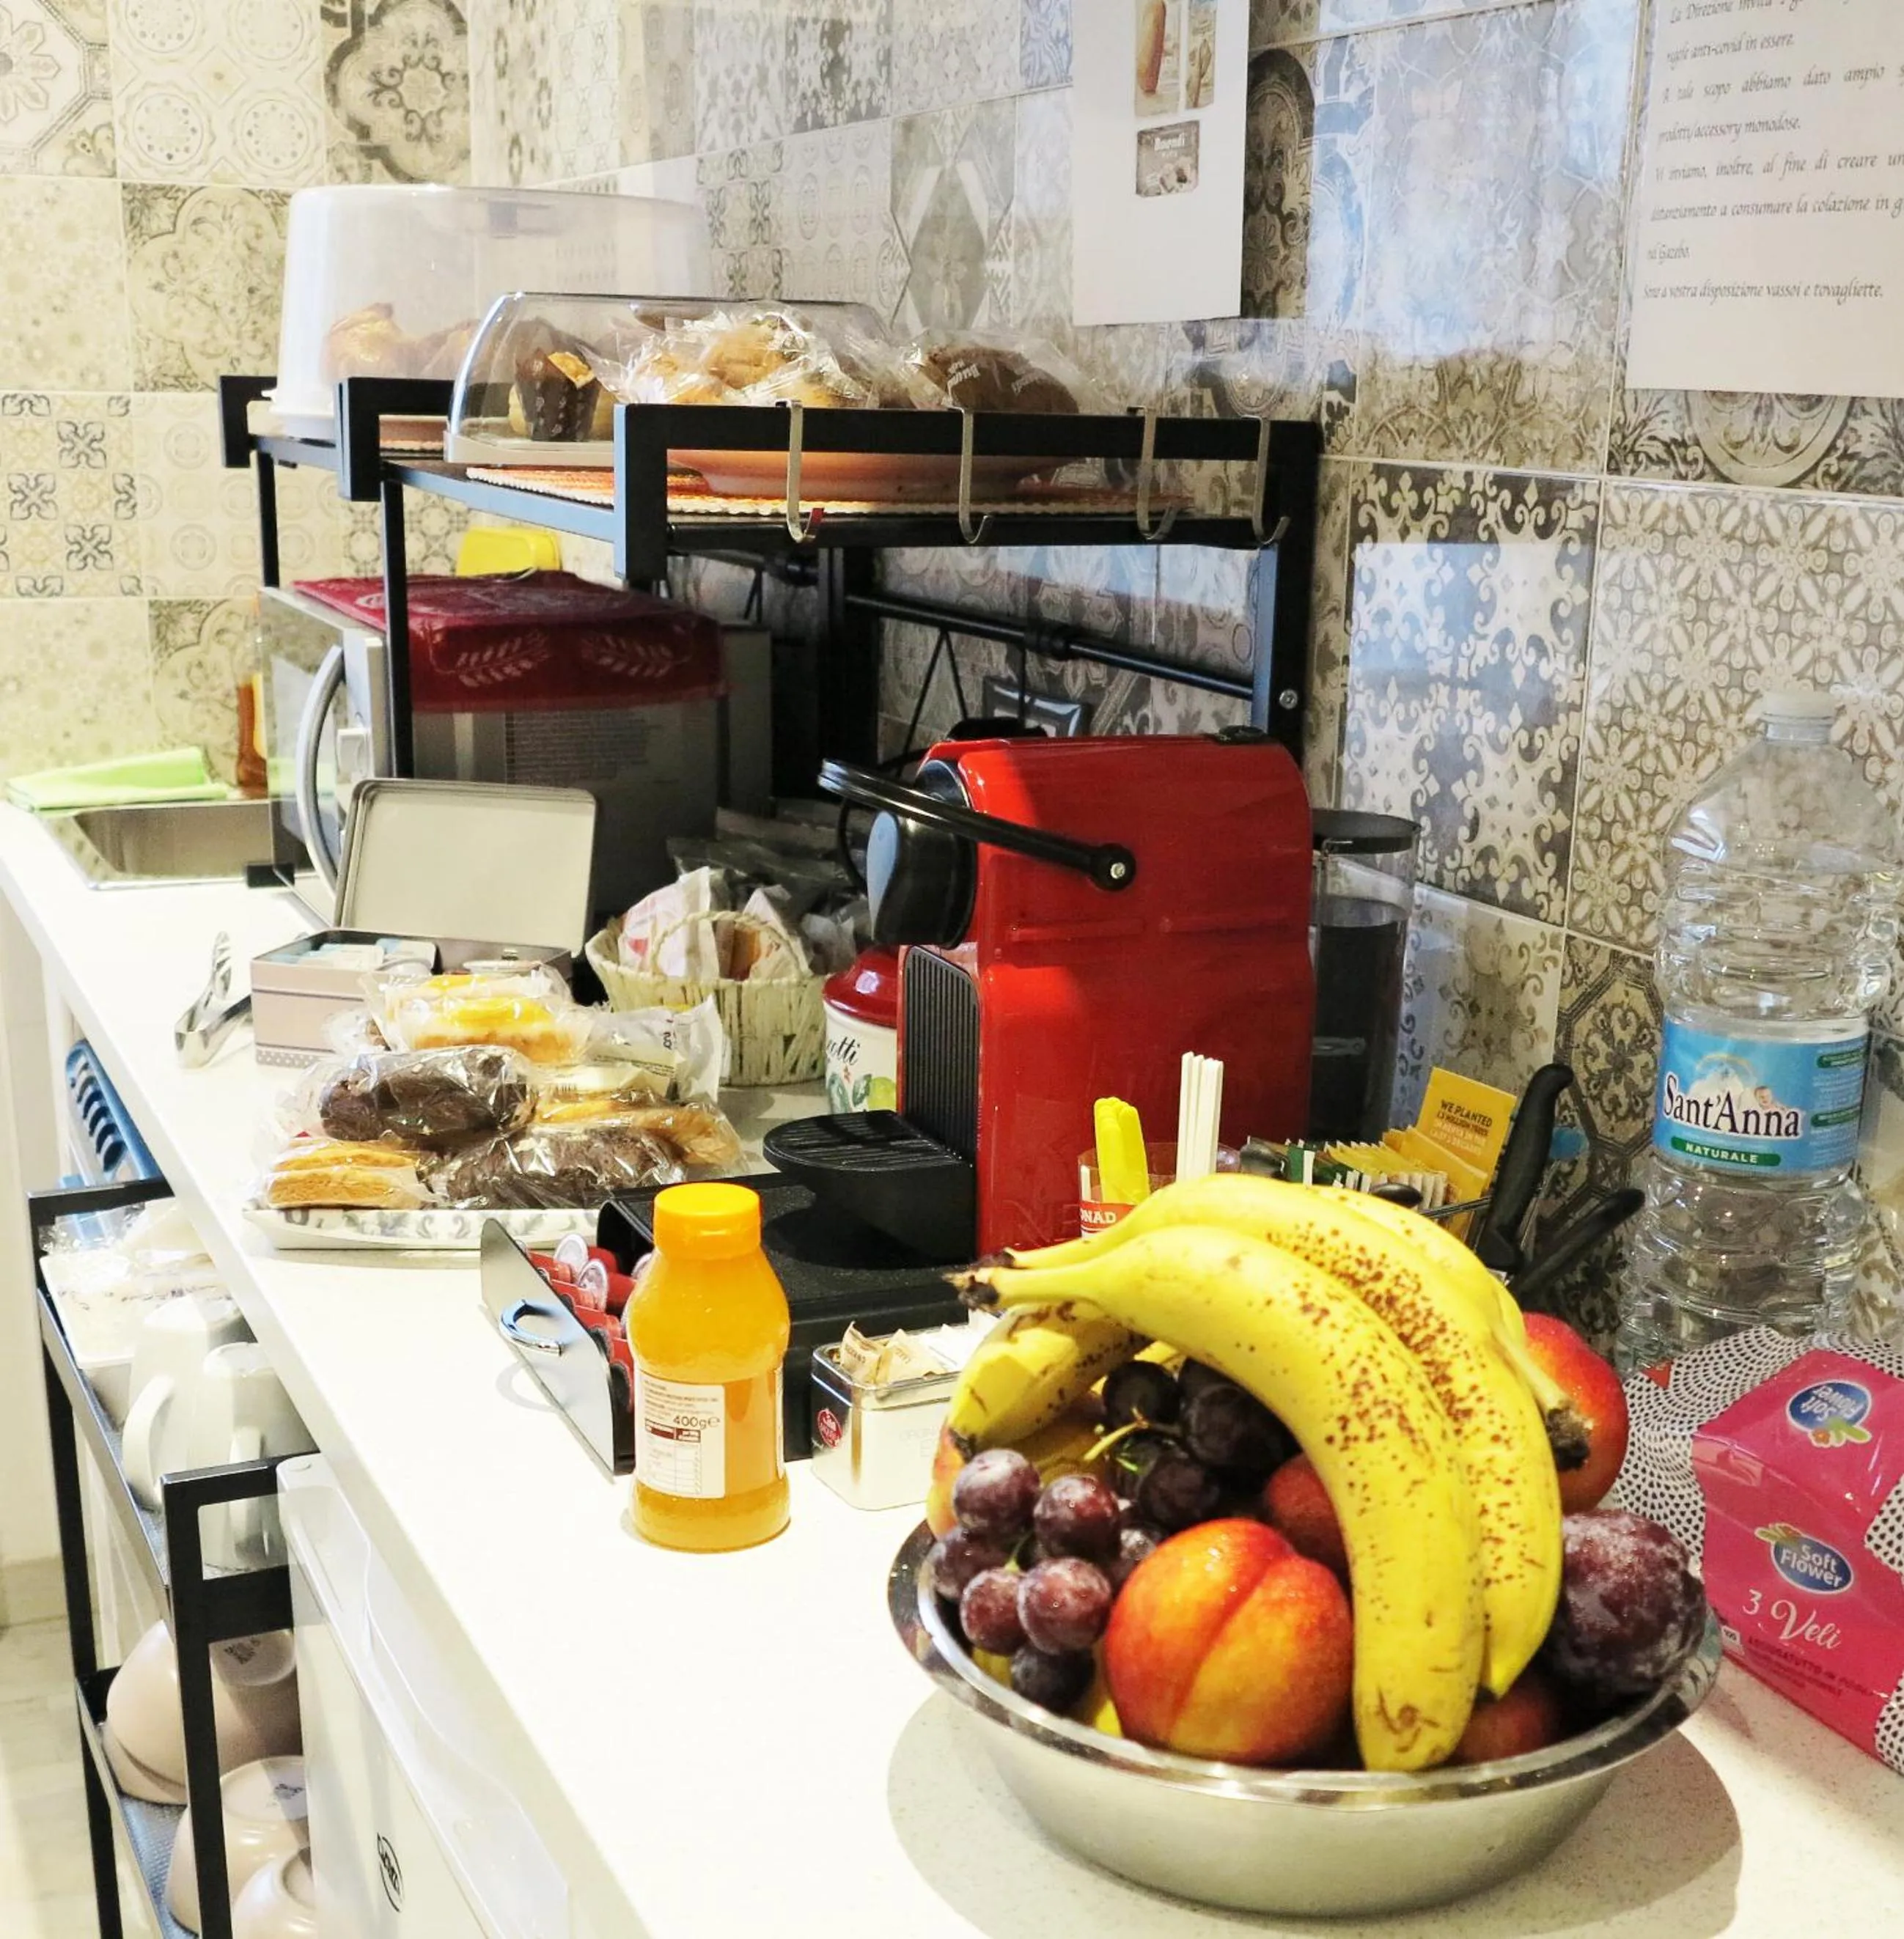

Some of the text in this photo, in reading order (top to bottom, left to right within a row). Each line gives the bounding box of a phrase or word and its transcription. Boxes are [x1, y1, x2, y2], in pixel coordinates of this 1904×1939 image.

[1704, 83, 1732, 103] scopo
[1741, 70, 1791, 95] abbiamo
[1803, 64, 1831, 87] dato
[1844, 62, 1885, 90] ampio
[1763, 152, 1779, 174] al
[1779, 151, 1806, 182] fine
[1815, 149, 1828, 171] di
[1837, 155, 1878, 169] creare
[1720, 204, 1727, 217] a
[1731, 199, 1792, 218] consumare
[1796, 193, 1808, 214] la
[1812, 191, 1871, 213] colazione
[1875, 194, 1889, 211] in
[1699, 278, 1764, 306] disposizione
[1767, 282, 1800, 298] vassoi
[1804, 284, 1811, 297] e
[1454, 1105, 1493, 1127] PLANTED
[1664, 1073, 1801, 1138] Sant'Anna
[1685, 1144, 1760, 1164] NATURALE
[1800, 1396, 1837, 1421] Soft
[1811, 1385, 1864, 1420] Flower
[1779, 1548, 1843, 1588] Flower
[1800, 1544, 1838, 1574] Soft
[1742, 1589, 1842, 1649] 3 Veli
